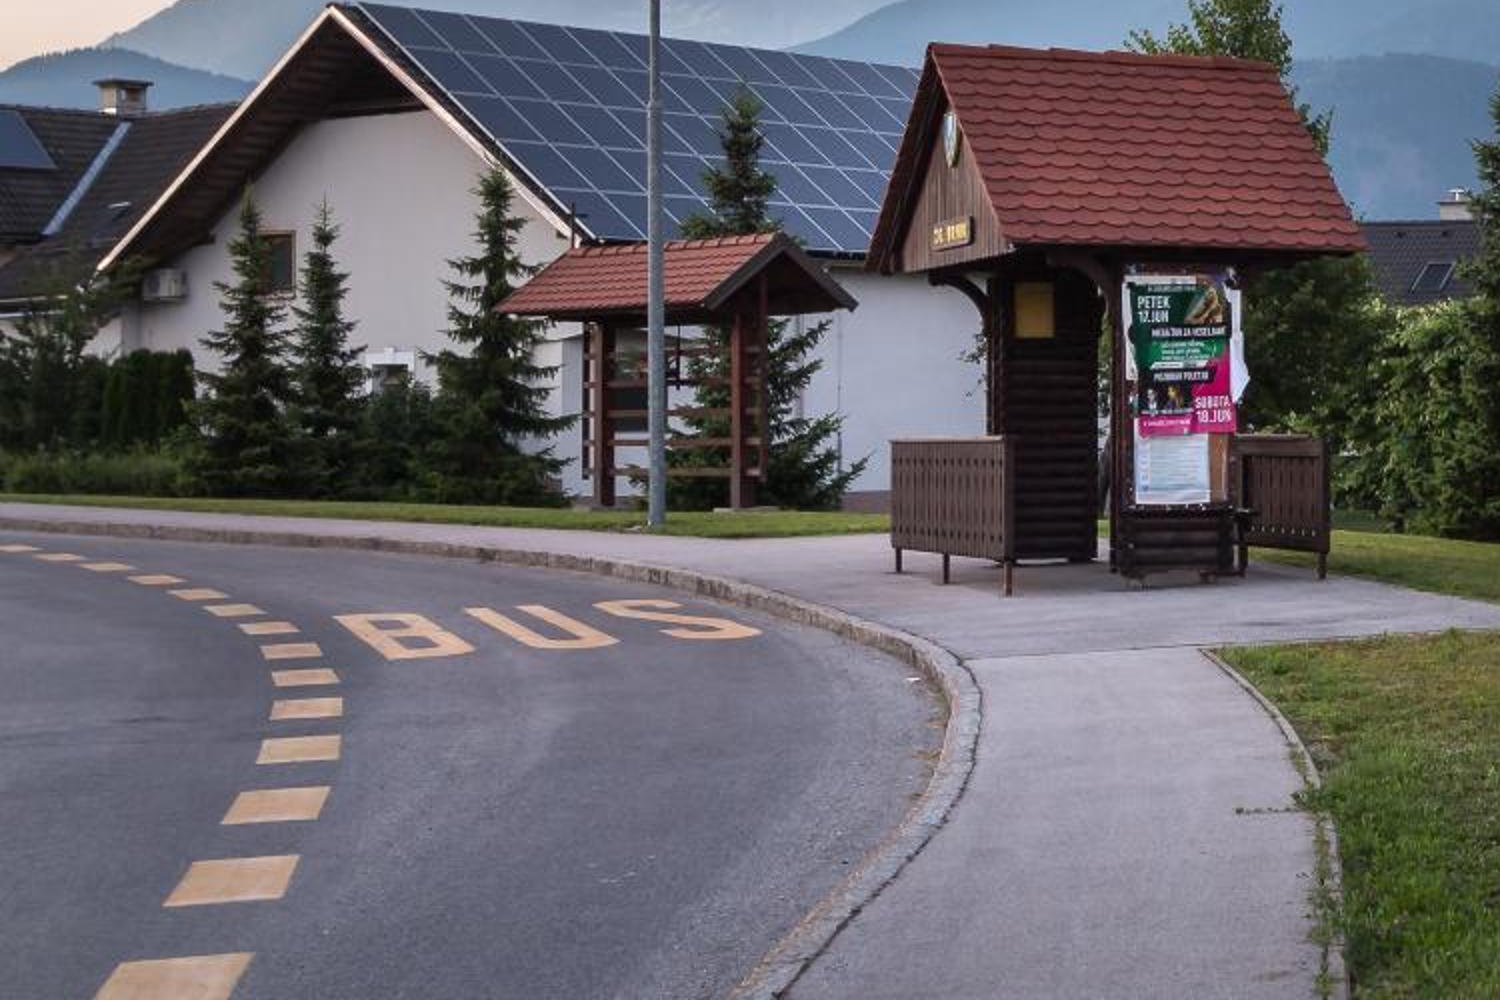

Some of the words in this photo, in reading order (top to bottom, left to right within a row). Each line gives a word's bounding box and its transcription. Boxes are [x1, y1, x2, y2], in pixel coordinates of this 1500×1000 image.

[1137, 295, 1171, 309] PETEK
[1195, 395, 1231, 409] SOBOTA
[1196, 409, 1232, 423] 18.JUN
[333, 599, 764, 661] BUS
